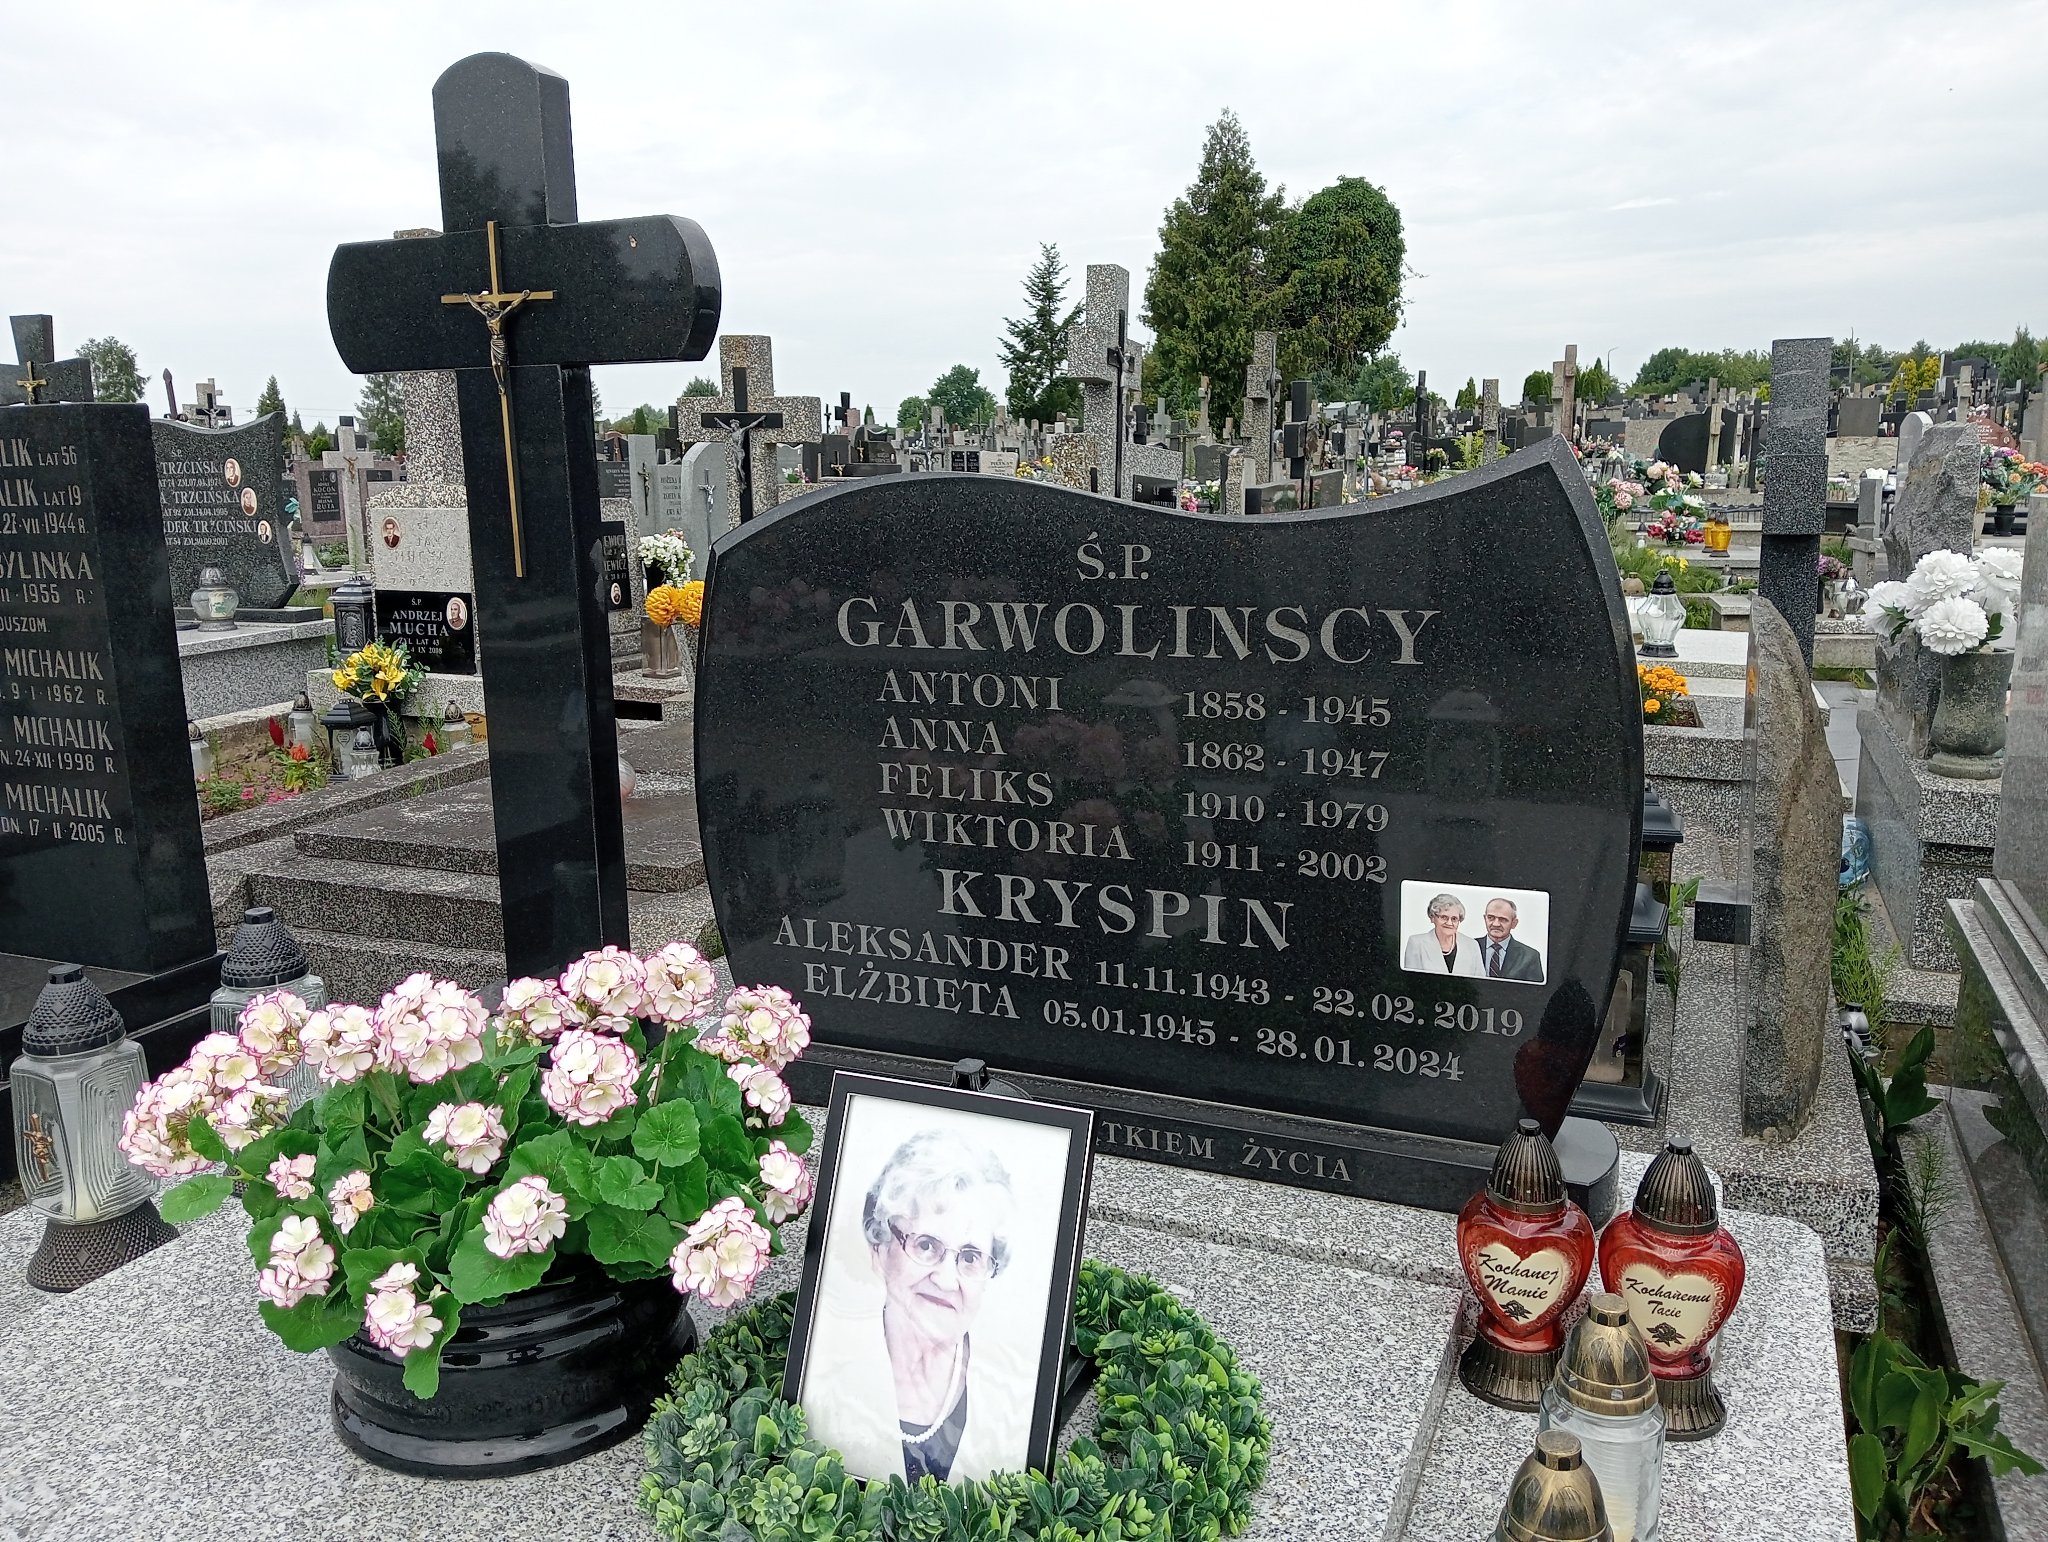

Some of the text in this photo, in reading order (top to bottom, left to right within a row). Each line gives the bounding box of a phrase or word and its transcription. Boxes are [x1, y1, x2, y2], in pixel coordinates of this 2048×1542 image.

[0, 438, 77, 467] LIK LAT 56
[43, 491, 66, 506] LAT
[68, 485, 82, 506] 19
[1076, 531, 1152, 580] Ś.P.
[389, 621, 450, 637] MUCHA
[392, 610, 443, 622] ANDRZEJ
[836, 596, 1442, 665] GARWOLINSCY
[416, 638, 429, 646] LAT
[4, 648, 104, 681] MICHALIK
[876, 668, 1064, 711] ANTONI
[1182, 690, 1267, 721] 1858
[1302, 695, 1392, 727] 1945
[13, 715, 115, 751] MICHALIK
[877, 715, 1008, 756] ANNA
[1181, 741, 1266, 772] 1862
[1301, 748, 1391, 779] 1947
[5, 782, 112, 820] MICHALIK
[877, 762, 1055, 808] FELIKS
[1181, 791, 1266, 822] 1910
[1300, 800, 1390, 832] 1979
[880, 807, 1136, 860] WIKTORIA
[1182, 840, 1264, 872] 1911
[1297, 849, 1388, 884] 2002
[936, 867, 1293, 952] KRYSPIN
[772, 914, 1073, 982] ALEKSANDER
[1094, 960, 1271, 1006] 11.11.1943
[802, 960, 1020, 1020] ELŻBIETA
[1043, 999, 1217, 1046] 05.01.1945
[1096, 1120, 1353, 1183] TKIEM ŻYCIA
[1477, 1252, 1561, 1285] Kochanej
[1483, 1274, 1549, 1300] Mamie
[1624, 1277, 1712, 1303] Kochanemu
[1647, 1299, 1683, 1318] Tacie
